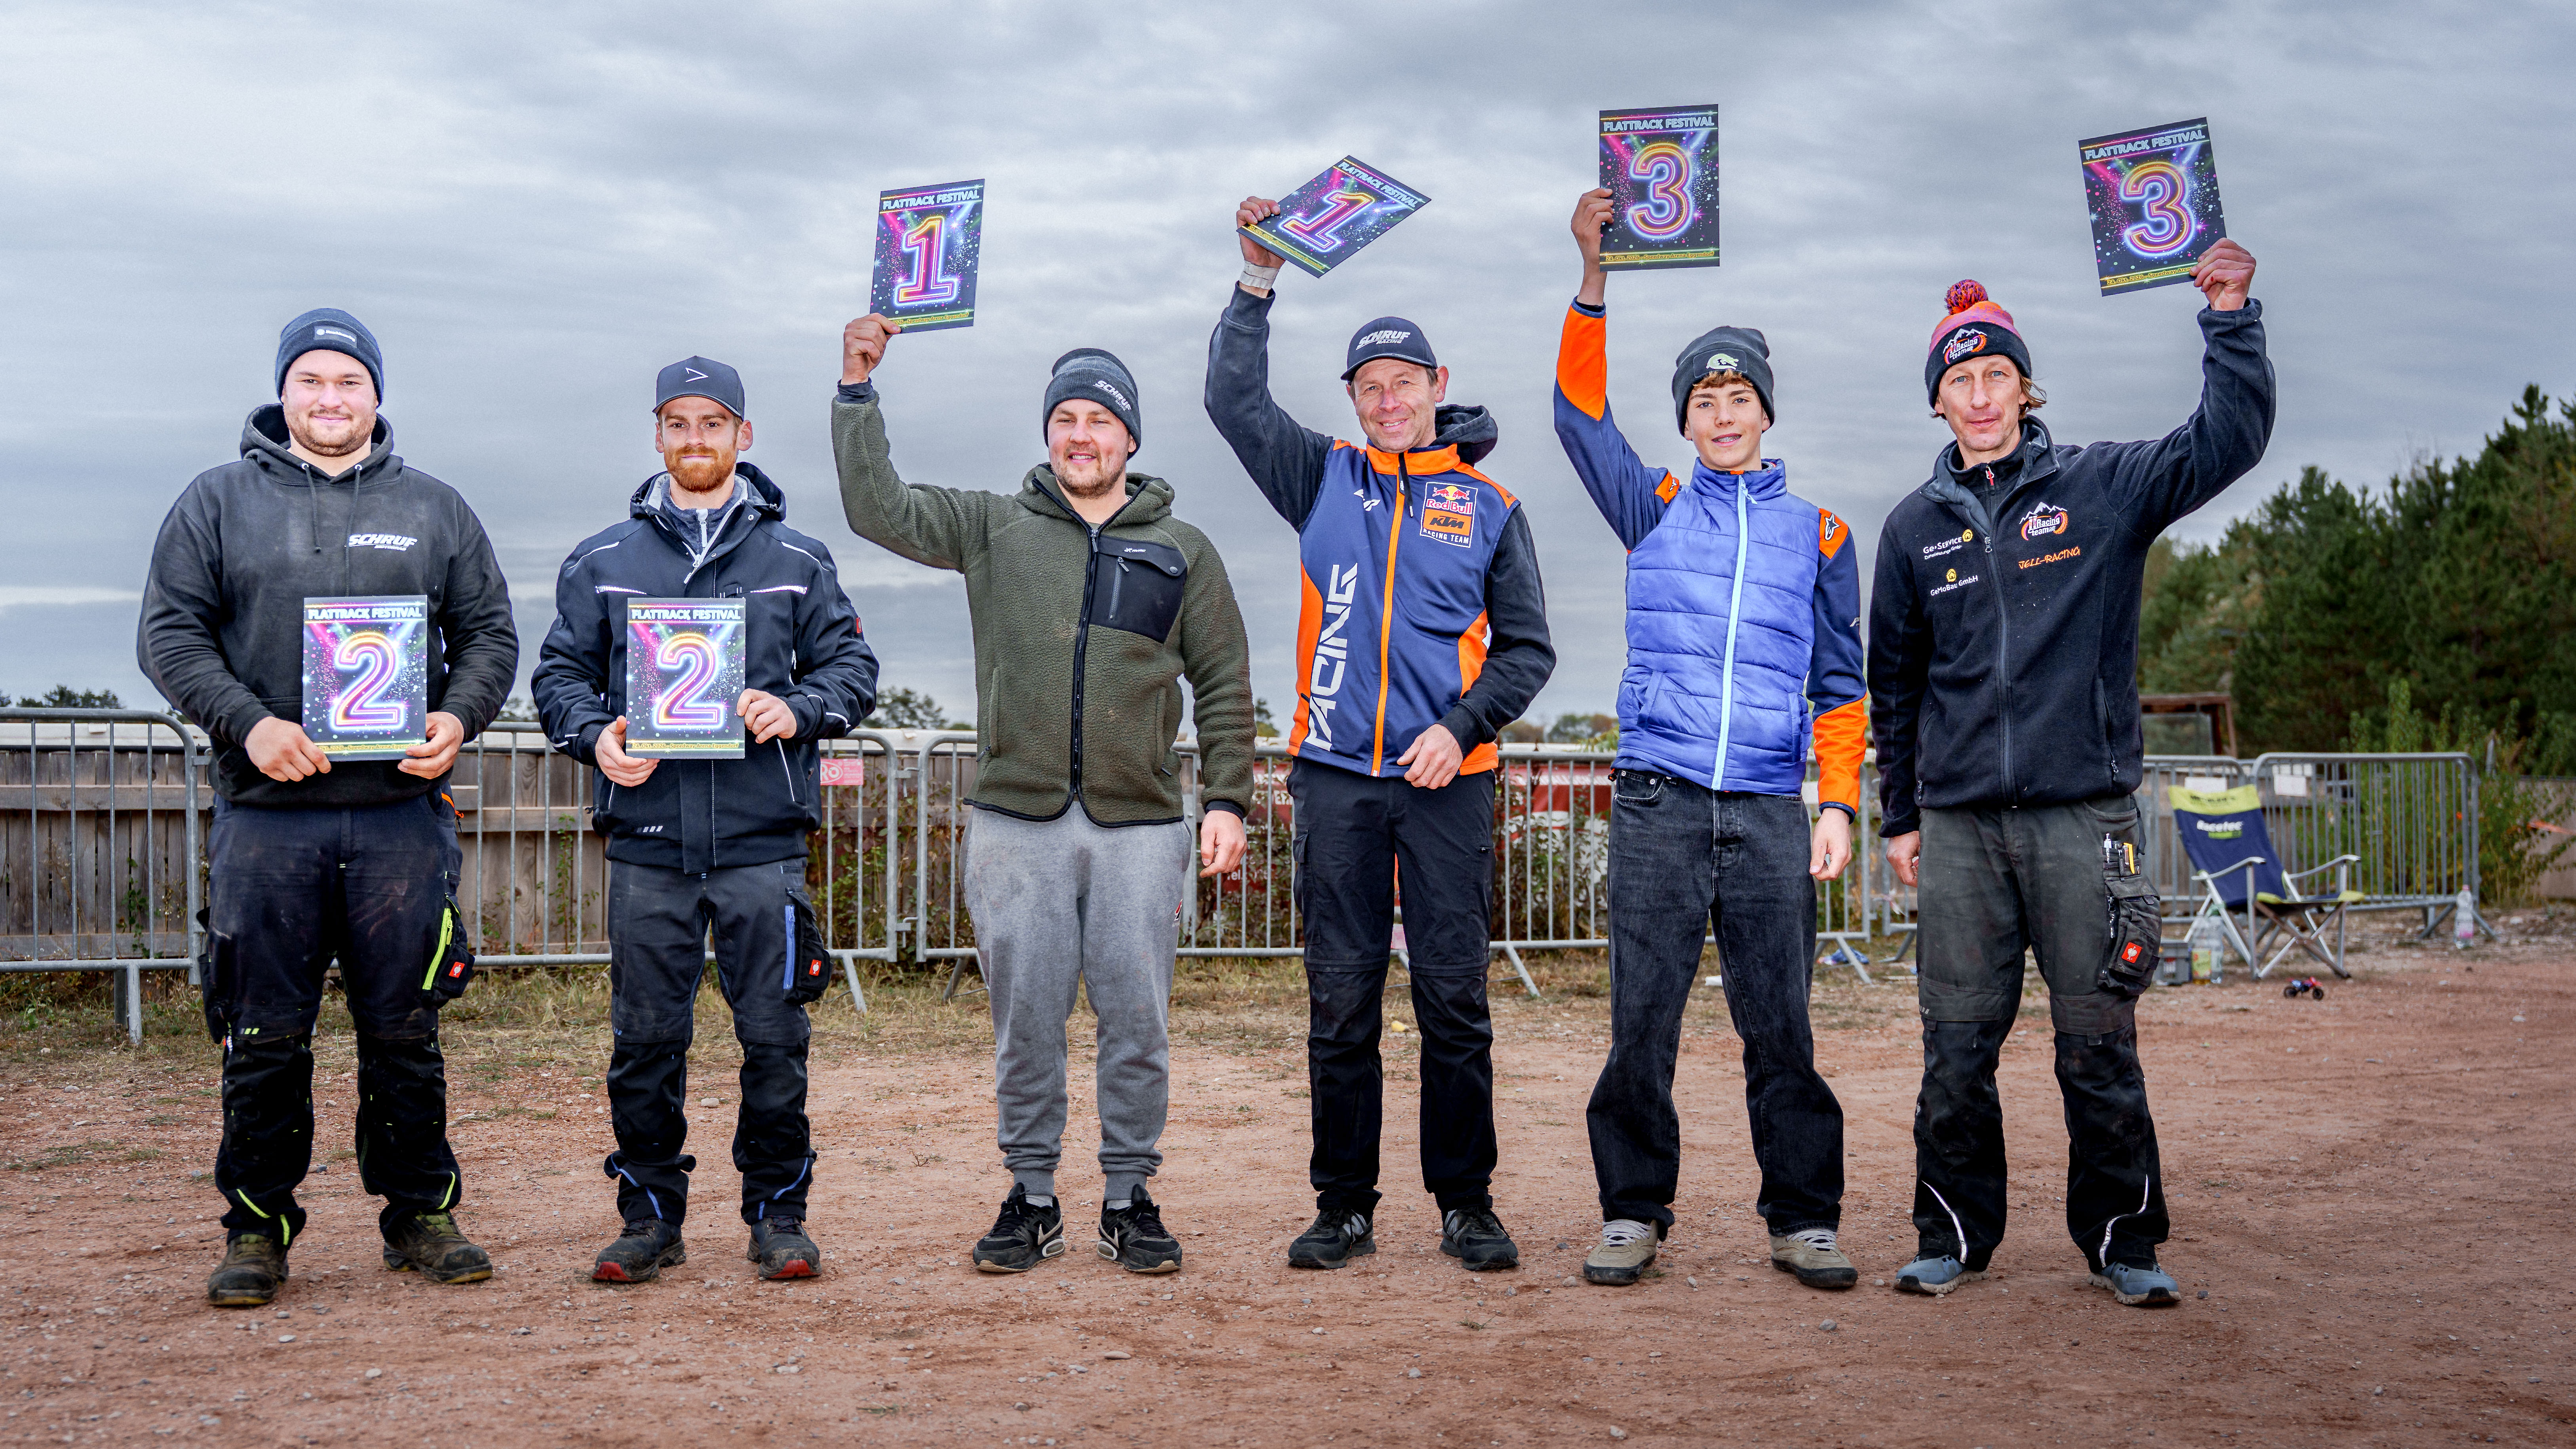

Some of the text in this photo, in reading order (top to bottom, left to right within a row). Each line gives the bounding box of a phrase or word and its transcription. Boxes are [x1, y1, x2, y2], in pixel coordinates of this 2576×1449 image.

[1604, 116, 1714, 132] FLATTRACK FESTIVAL
[2085, 129, 2205, 160] FLATTRACK FESTIVAL
[1338, 162, 1418, 208] FLATTRACK FESTIVAL
[1628, 143, 1693, 239] 3
[882, 189, 979, 210] FLATTRACK FESTIVAL
[2120, 161, 2196, 259] 3
[1279, 190, 1375, 253] 1
[895, 216, 958, 306] 1
[1274, 240, 1293, 253] Speedway
[1293, 251, 1304, 259] Arena
[1304, 257, 1325, 270] Eggendorf
[2148, 269, 2177, 278] Speedway
[1357, 330, 1411, 346] SCHRUF
[1956, 338, 1978, 350] Racing
[1094, 380, 1132, 411] SCHRUF
[1426, 499, 1473, 514] Red Bull
[1430, 515, 1464, 529] KTM
[2036, 517, 2060, 528] Racing
[349, 533, 418, 547] SCHRUF
[1423, 528, 1469, 544] RACING TEAM
[1930, 575, 1978, 596] GeMoBau GmbH
[308, 607, 422, 620] FLATTRACK FESTIVAL
[633, 609, 741, 620] FLATTRACK FESTIVAL
[1304, 563, 1358, 751] RACING
[330, 631, 405, 731] 2
[652, 632, 725, 730] 2
